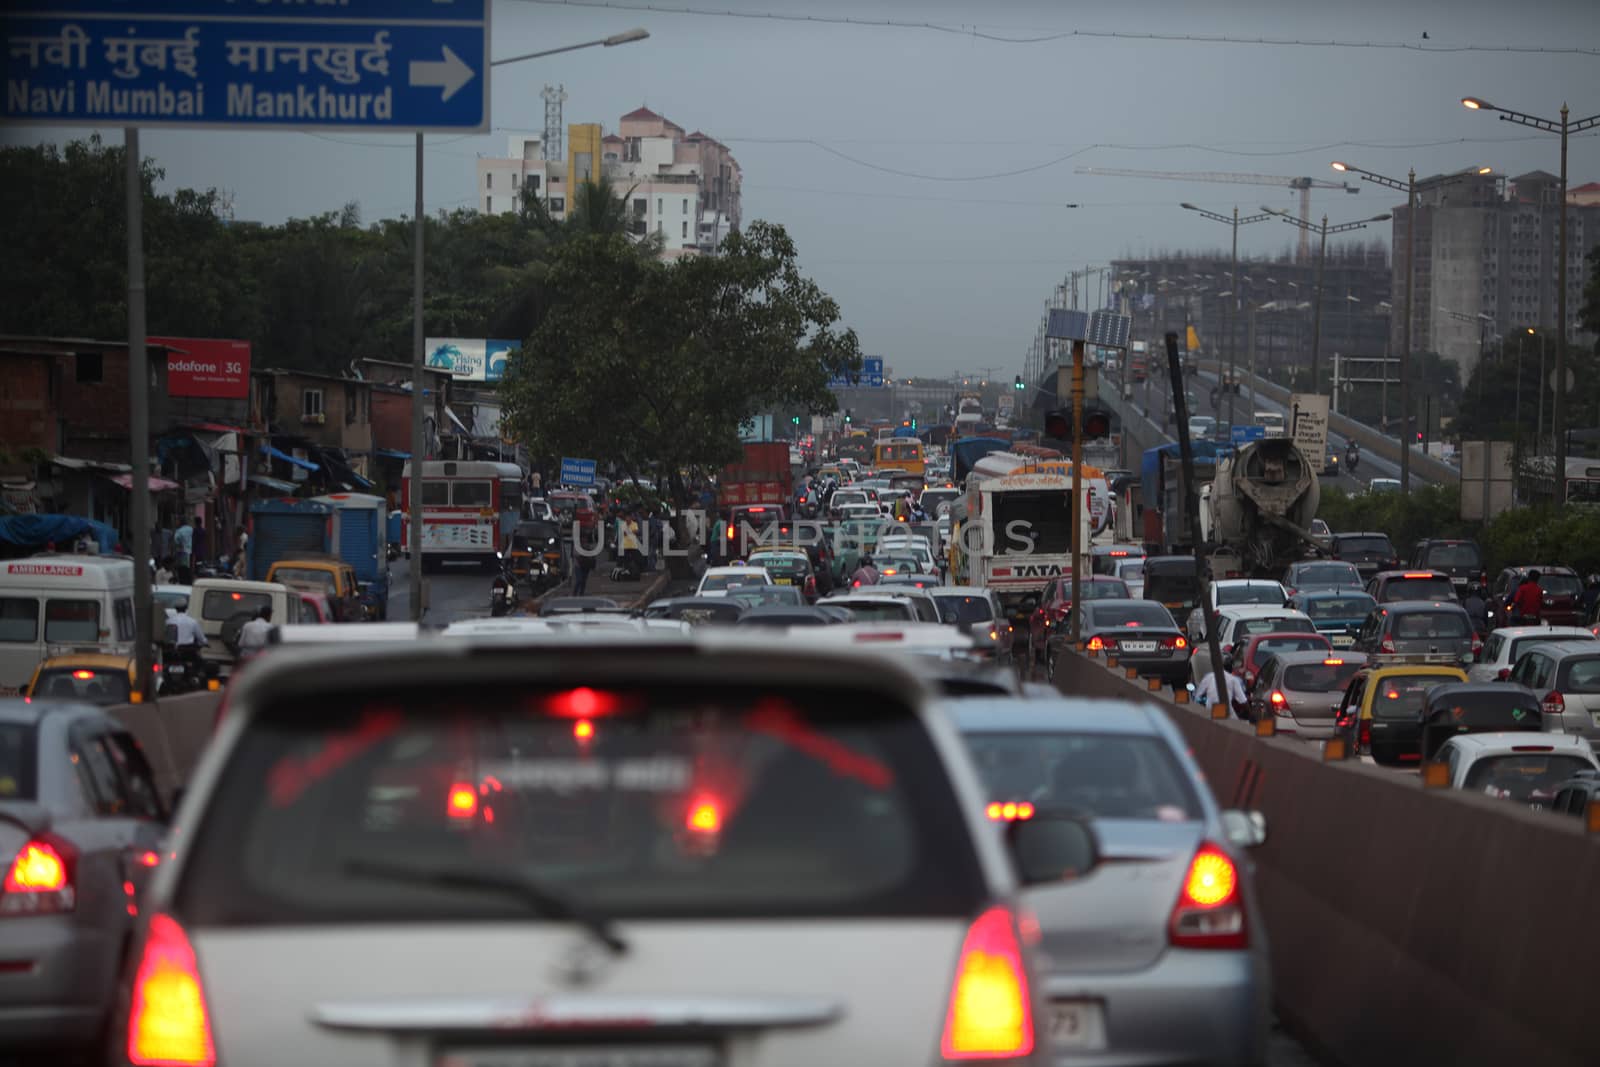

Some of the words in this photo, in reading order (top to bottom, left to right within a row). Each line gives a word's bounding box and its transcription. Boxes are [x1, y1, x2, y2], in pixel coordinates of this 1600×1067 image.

[8, 24, 91, 69] नवी
[103, 27, 200, 79] मुंबई
[225, 31, 392, 84] मानखुर्द
[7, 80, 75, 115] Navi
[86, 80, 204, 116] Mumbai
[227, 83, 392, 120] Mankhurd
[168, 360, 217, 374] odafone
[224, 361, 242, 375] 3G
[13, 564, 78, 576] AMBULANCE
[1014, 564, 1062, 577] TATA
